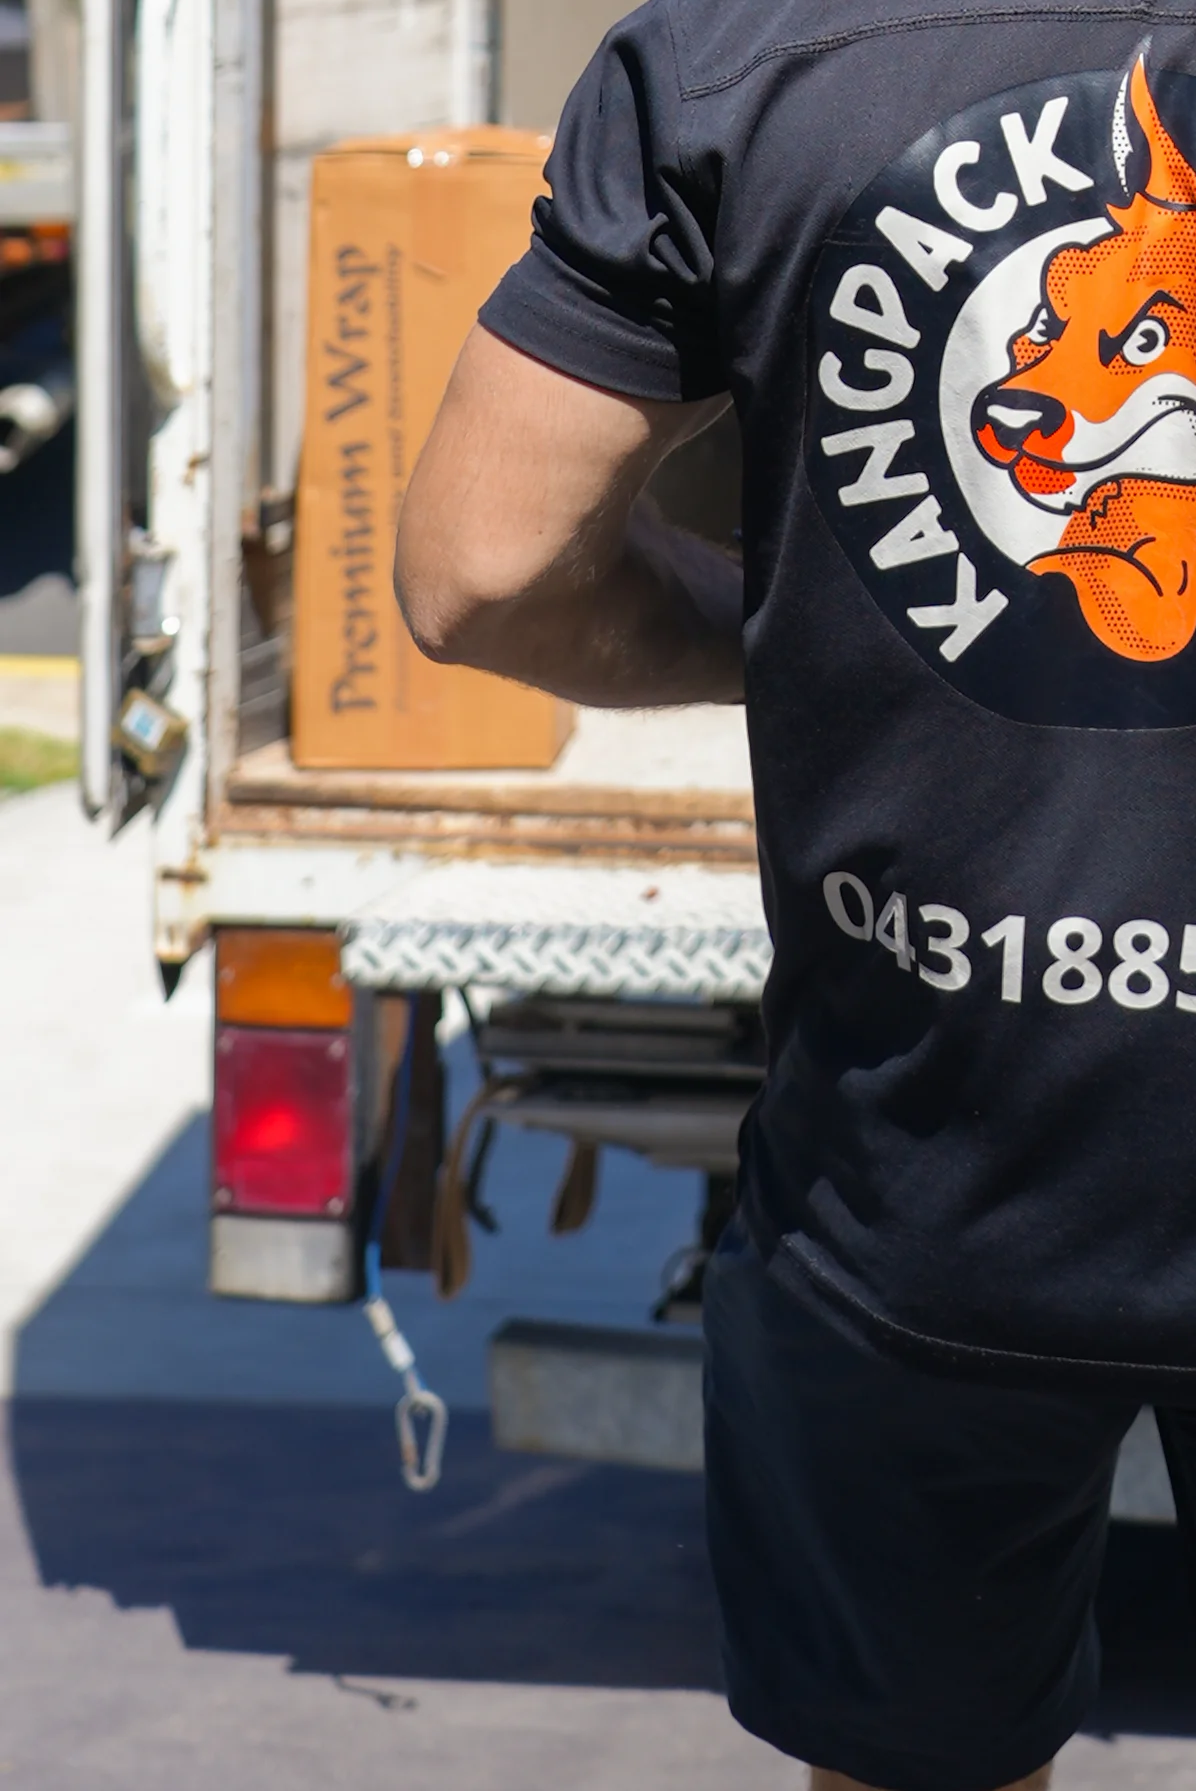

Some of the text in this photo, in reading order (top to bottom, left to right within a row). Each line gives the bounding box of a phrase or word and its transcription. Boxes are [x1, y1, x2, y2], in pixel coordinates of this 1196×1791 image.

[324, 244, 380, 715] Premium Wrap
[818, 96, 1095, 662] KANGPACK
